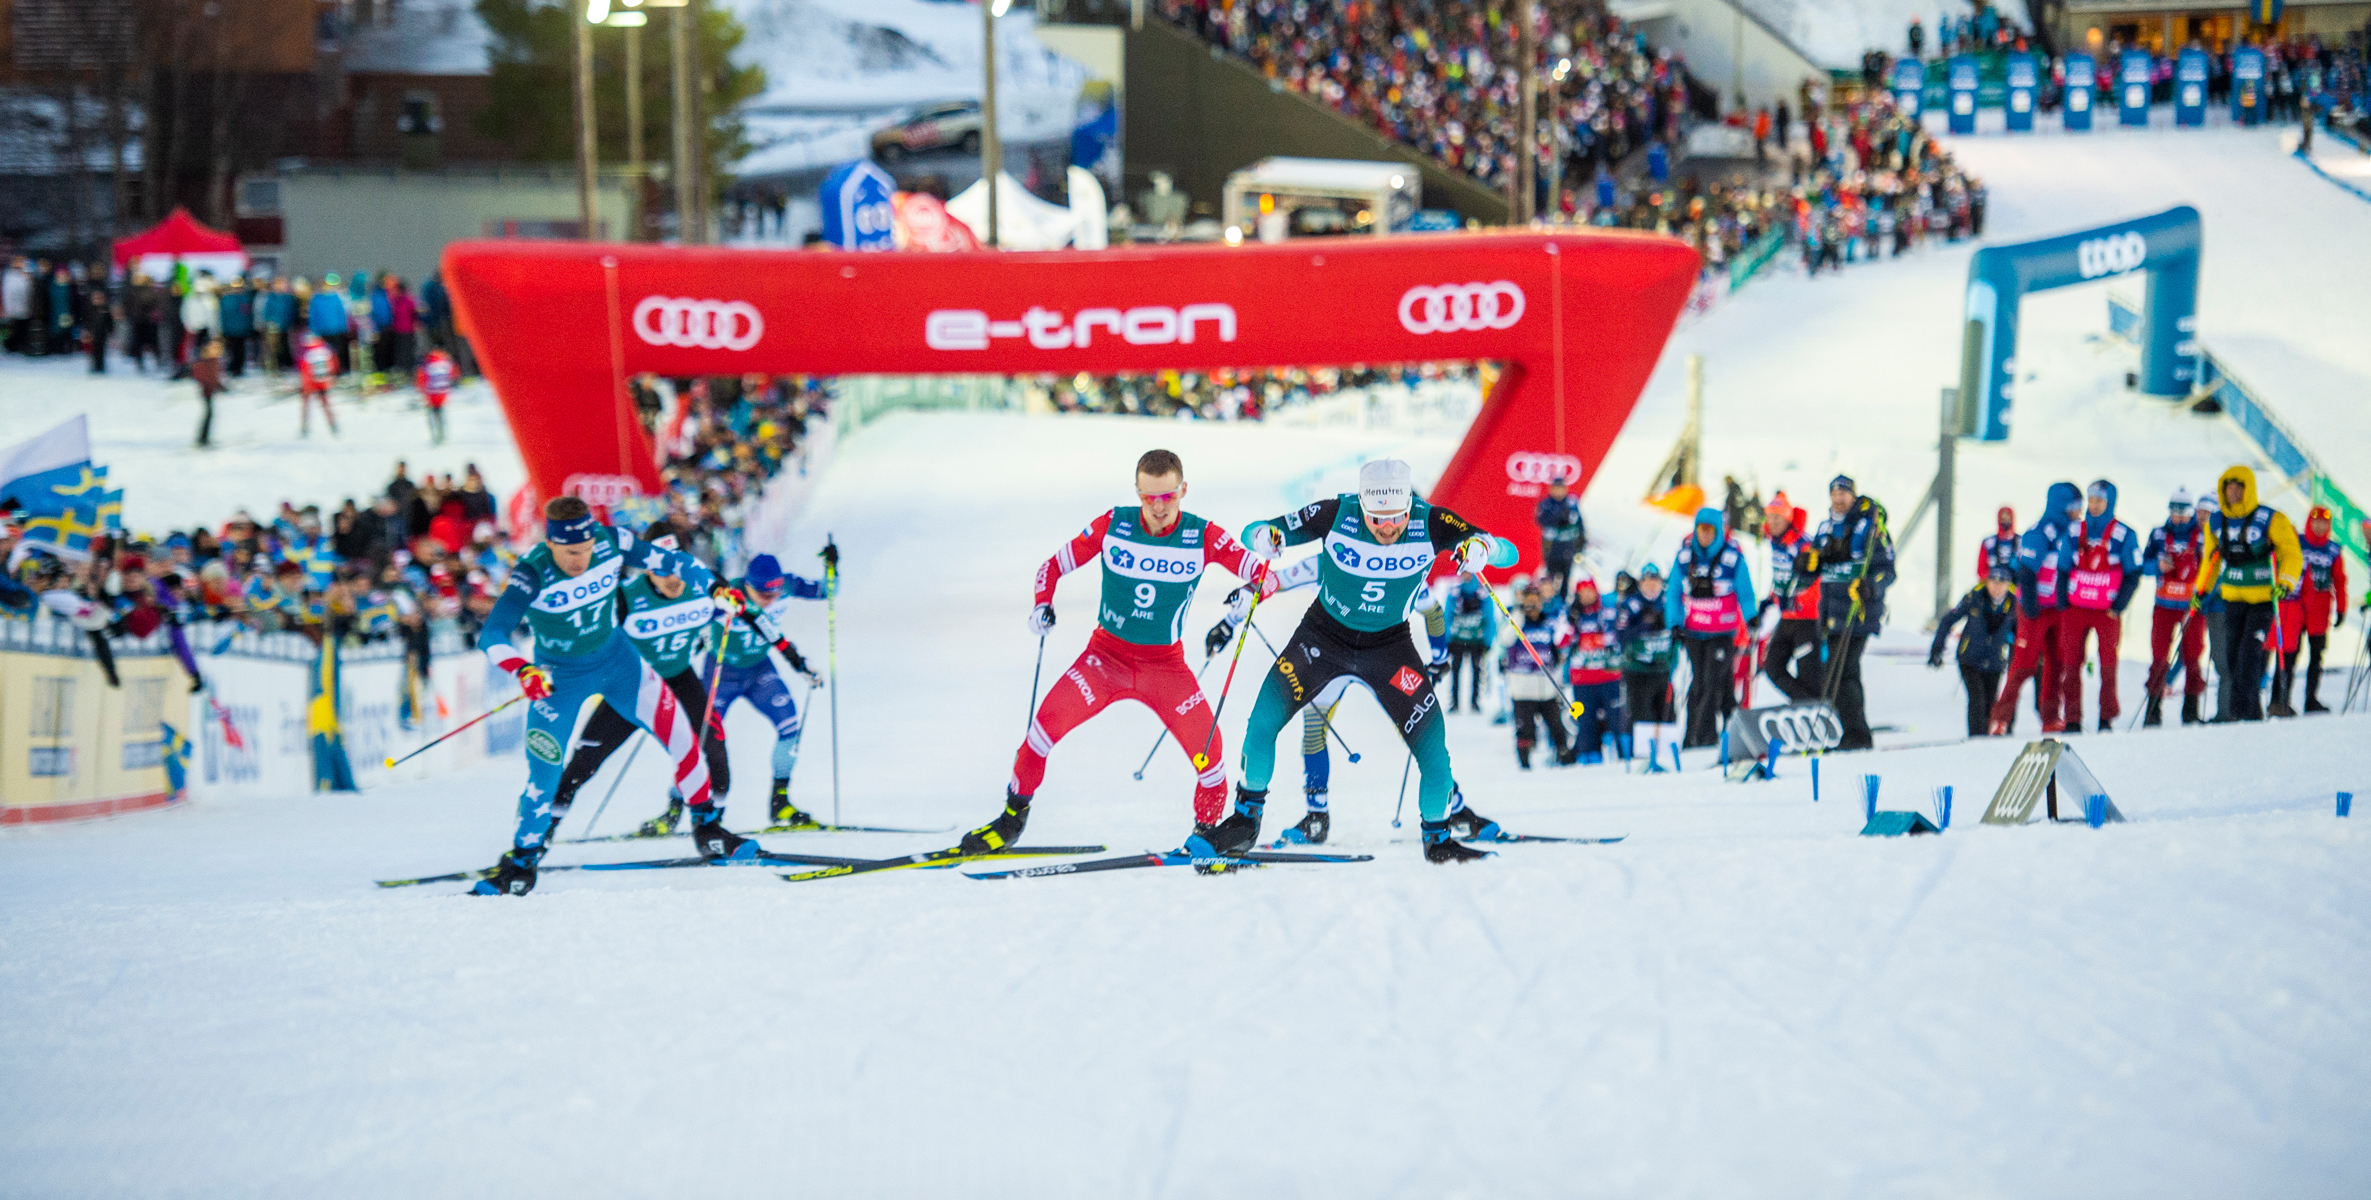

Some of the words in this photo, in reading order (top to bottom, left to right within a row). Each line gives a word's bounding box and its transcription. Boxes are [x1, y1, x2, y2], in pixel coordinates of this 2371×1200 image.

[925, 303, 1237, 350] e-tron
[1440, 512, 1468, 532] somfy
[1140, 558, 1196, 575] OBOS
[1366, 554, 1428, 572] OBOS
[573, 567, 621, 599] OBOS
[1361, 581, 1386, 602] 5
[1134, 583, 1156, 608] 9
[566, 600, 607, 628] 17
[662, 606, 710, 628] OBOS
[651, 631, 690, 653] 15
[1066, 668, 1096, 706] LUKOIL
[1276, 656, 1303, 701] somfy
[532, 701, 560, 723] VISA
[1404, 693, 1435, 734] odlo
